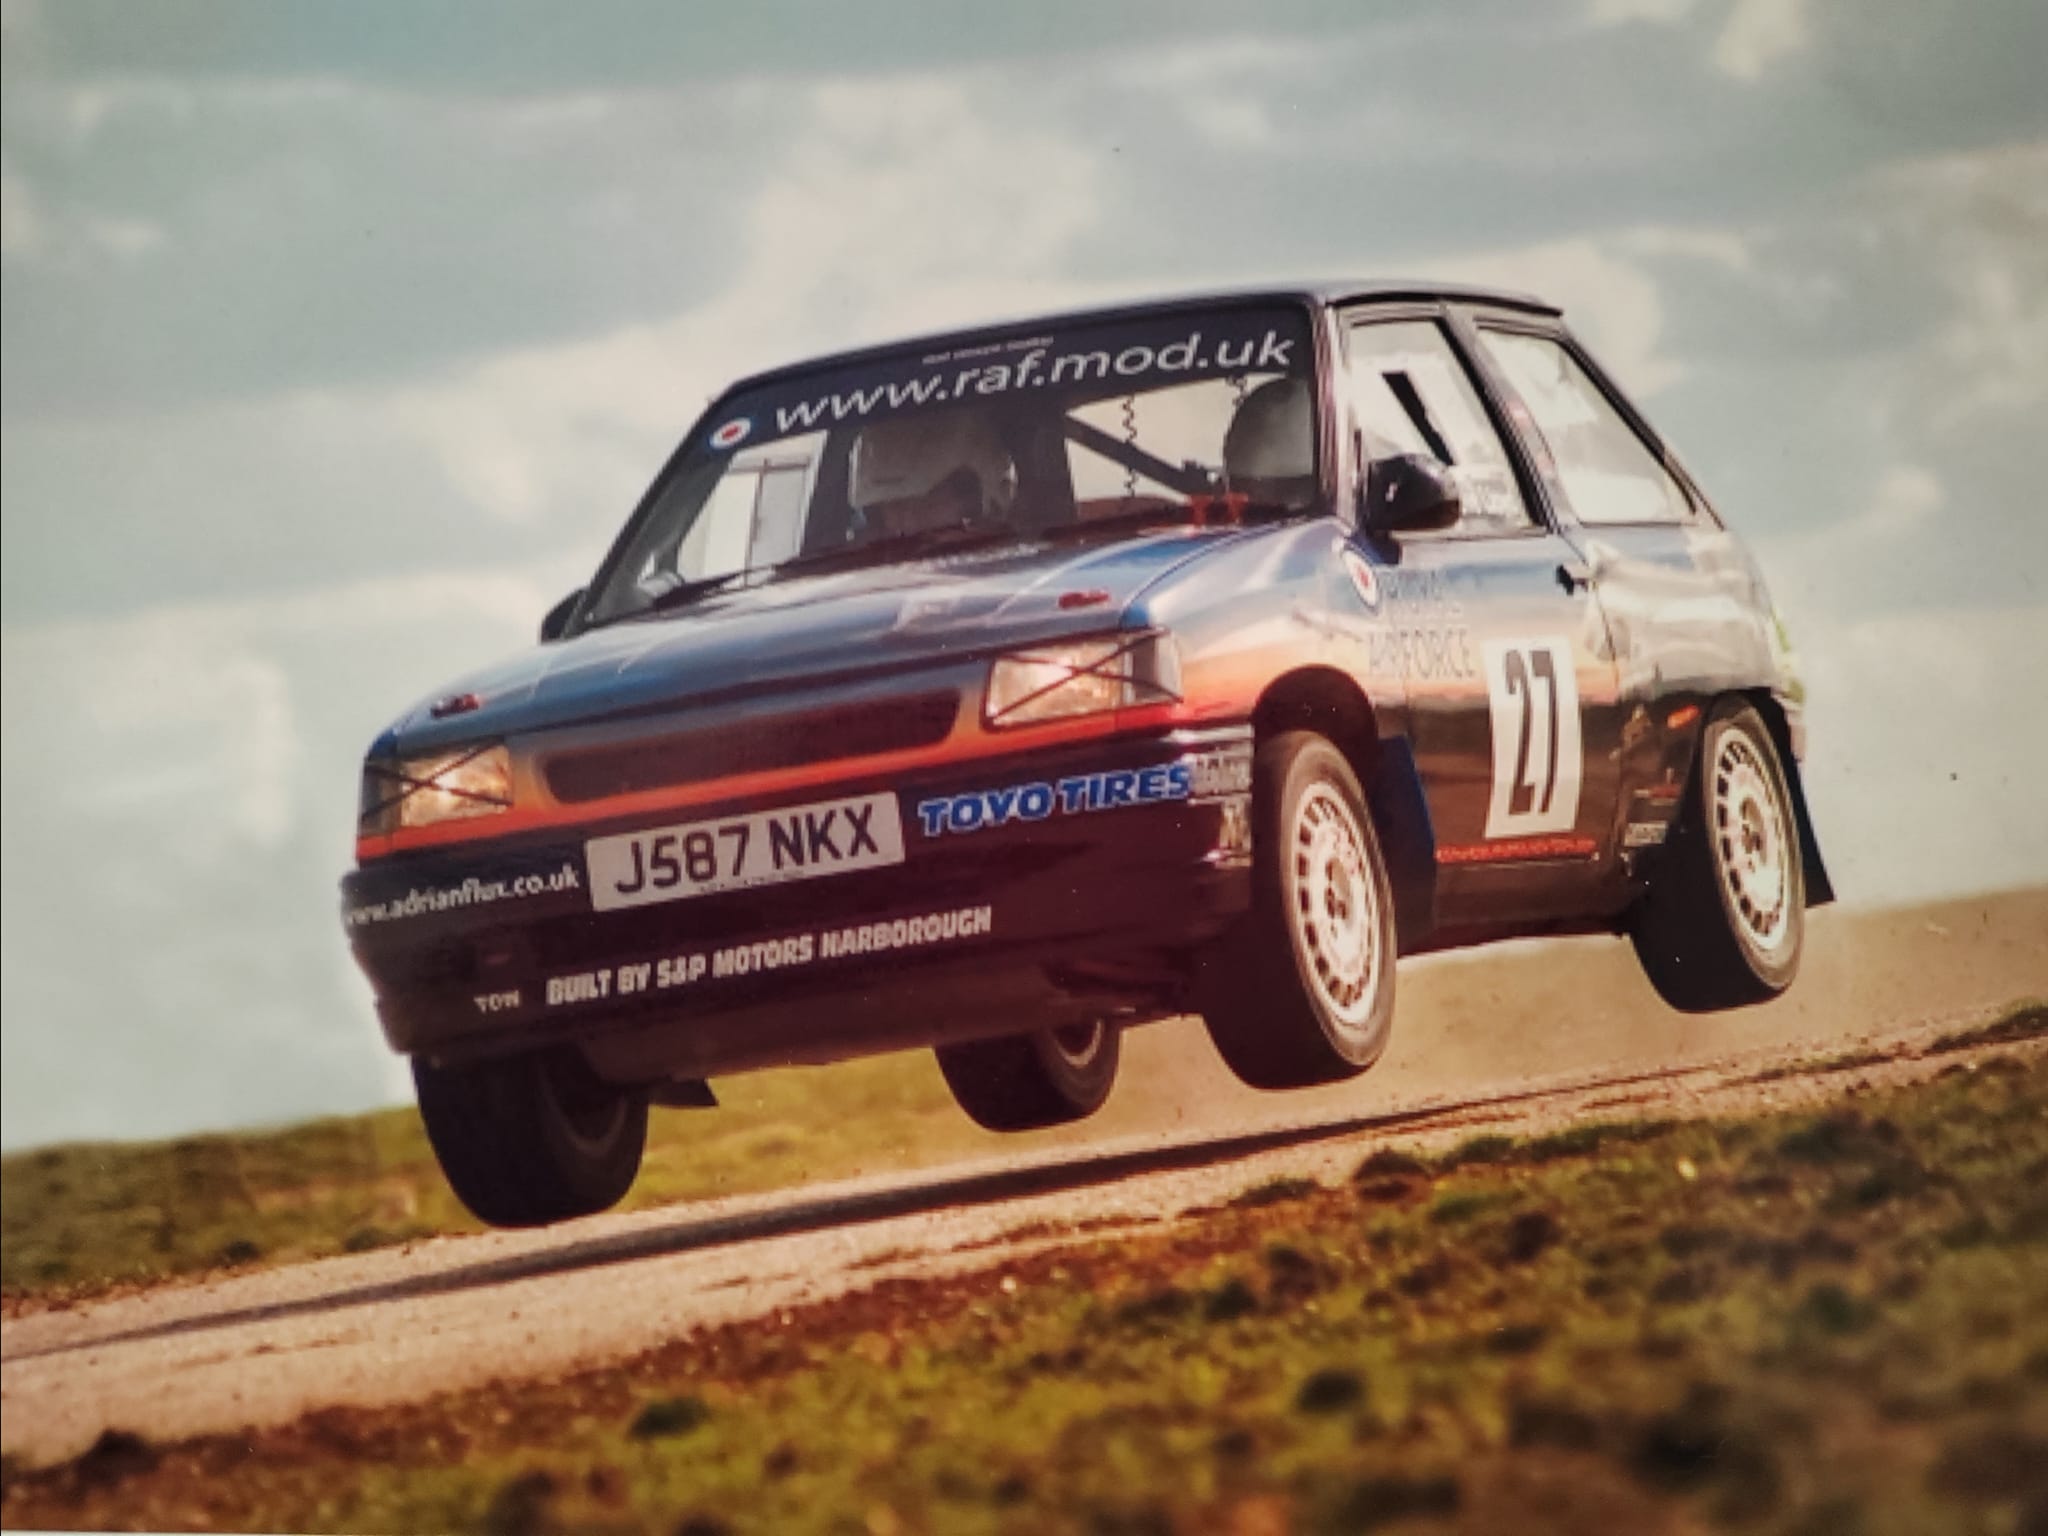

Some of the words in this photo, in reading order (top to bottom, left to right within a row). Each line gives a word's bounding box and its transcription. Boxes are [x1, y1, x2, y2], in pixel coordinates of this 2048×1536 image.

[775, 329, 1294, 433] www.raf.mod.uk
[1505, 649, 1560, 816] 27
[614, 822, 750, 893] J587
[769, 803, 878, 870] NKX
[917, 782, 1054, 837] TOYO
[1058, 762, 1191, 814] TIRES
[546, 969, 612, 1006] BUILT
[617, 962, 651, 995] BY
[656, 952, 707, 988] S&P
[712, 934, 814, 978] MOTORS
[820, 905, 992, 958] HARBOROUGH
